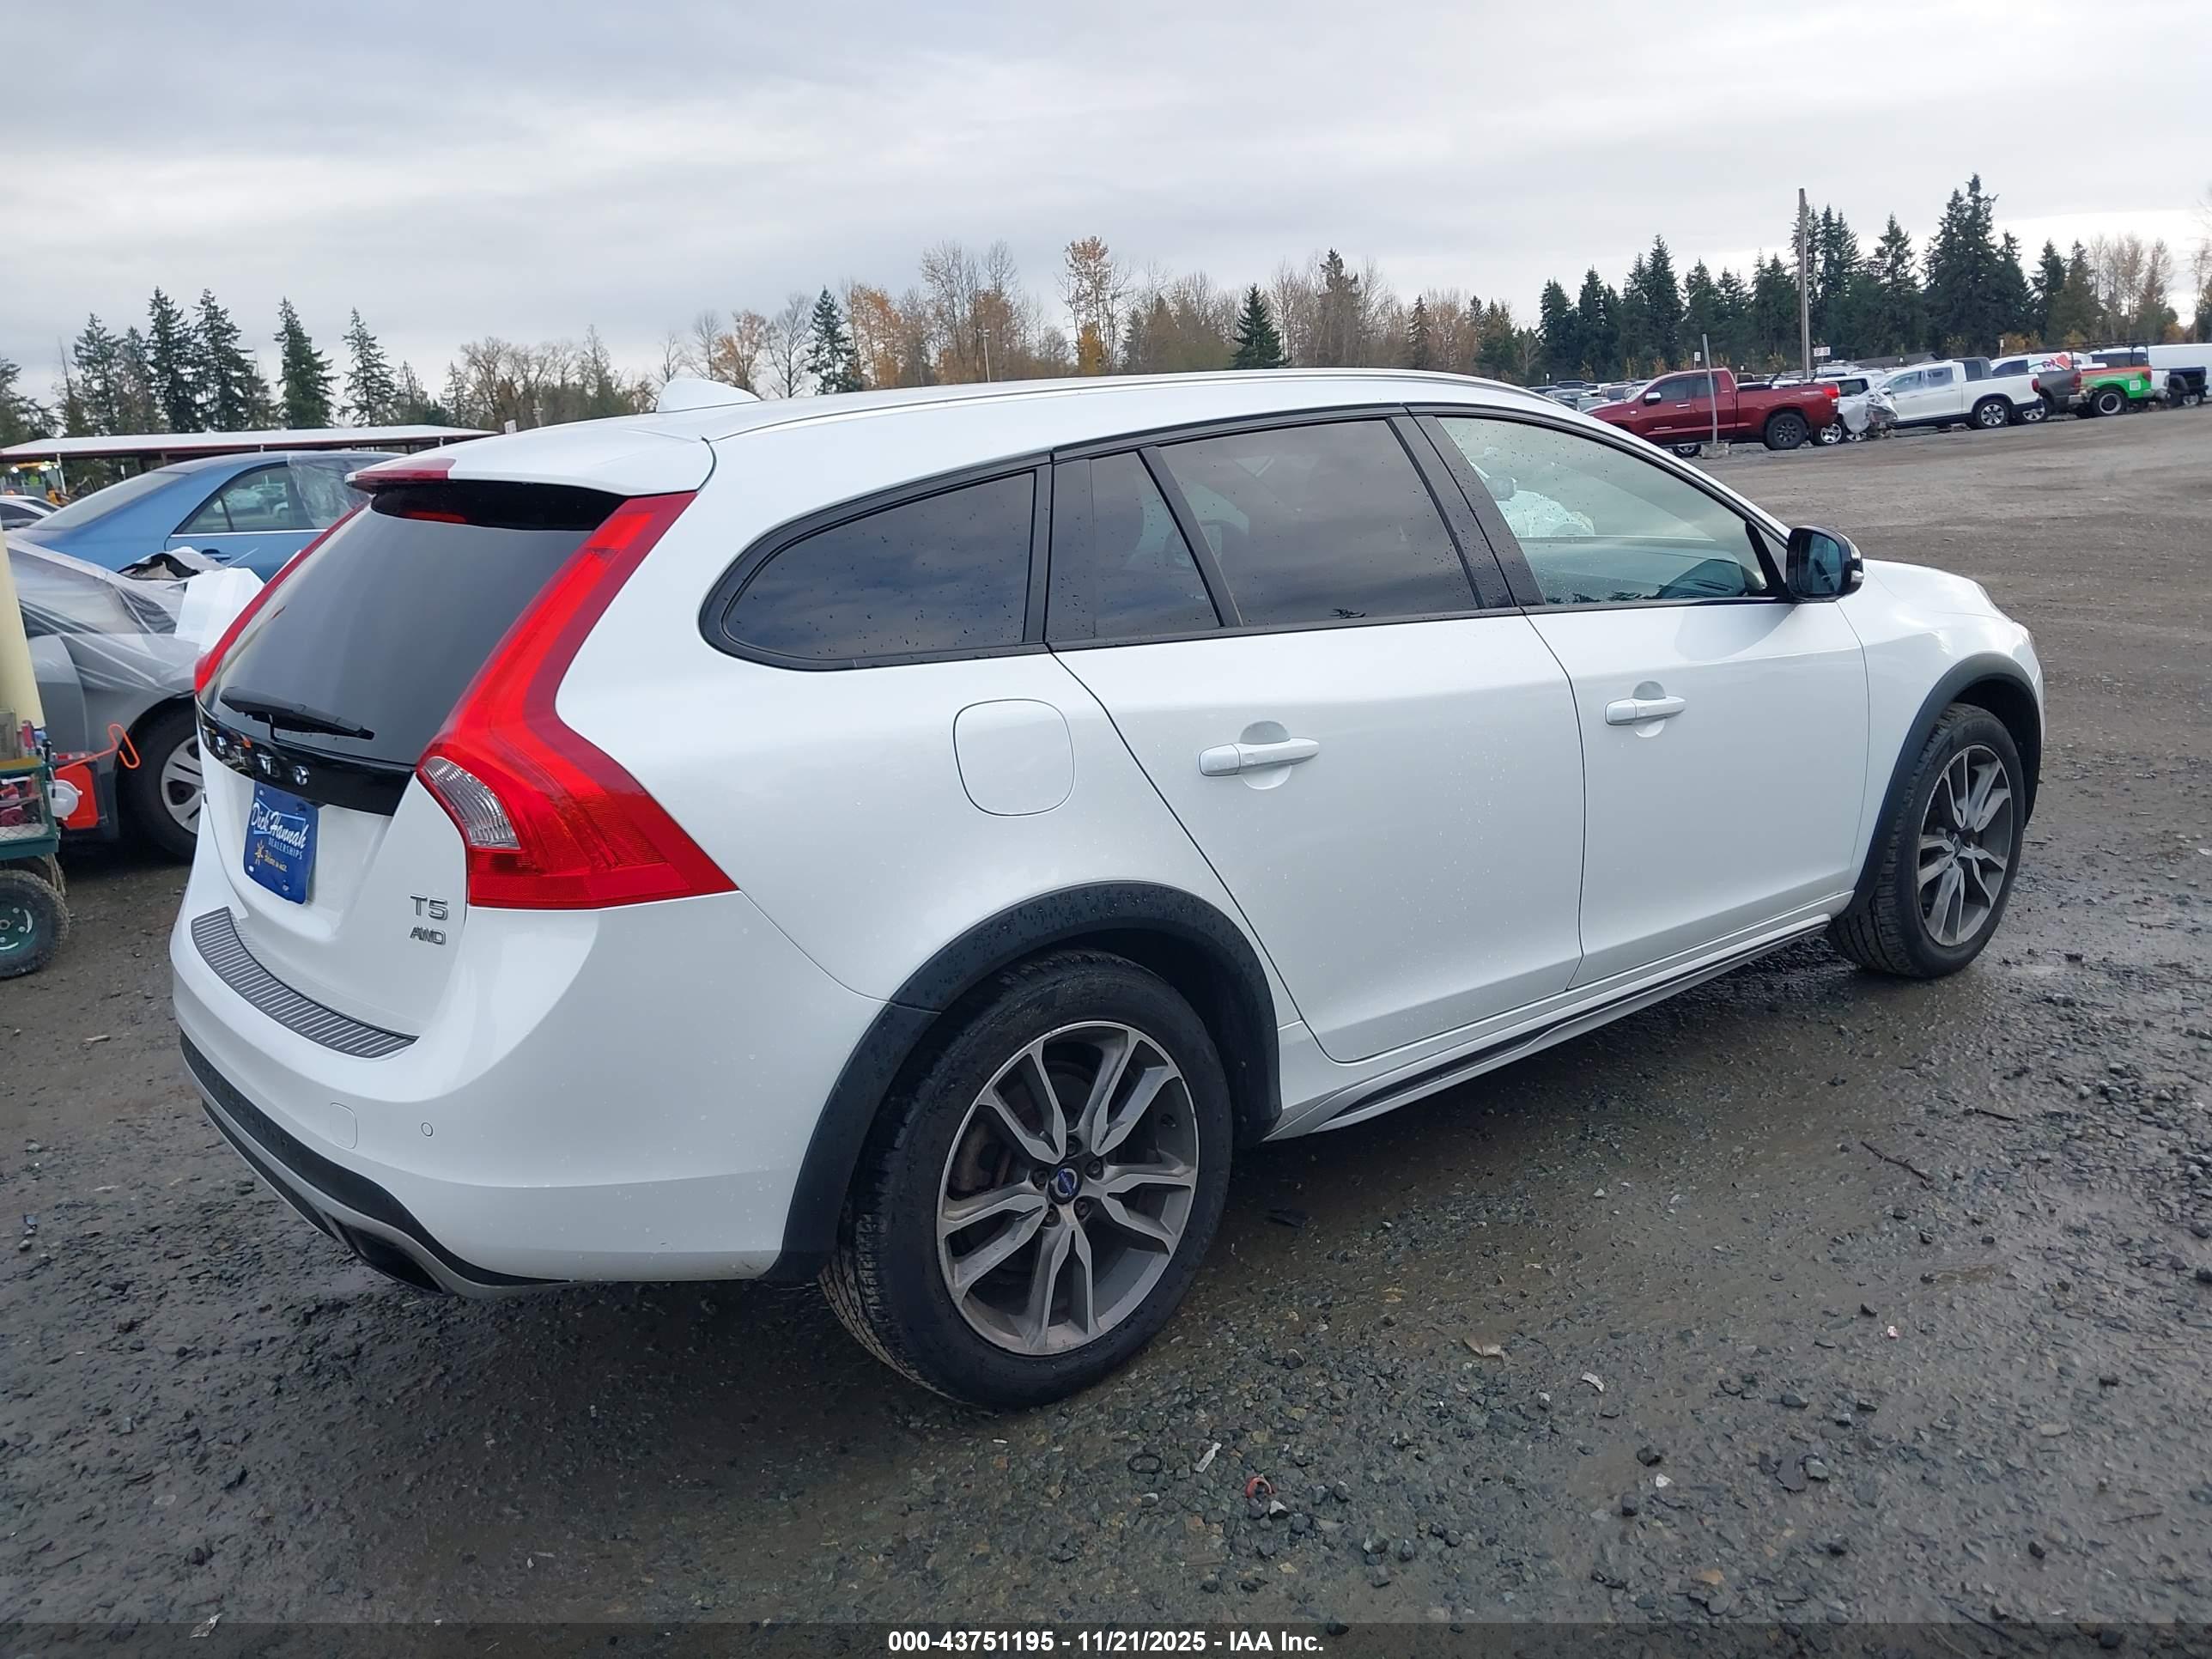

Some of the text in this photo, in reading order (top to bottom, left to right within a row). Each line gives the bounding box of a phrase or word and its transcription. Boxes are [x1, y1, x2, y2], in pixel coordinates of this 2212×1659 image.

[251, 801, 309, 848] Dick Hannah
[268, 837, 303, 860] DEALERSHIPS
[410, 893, 448, 921] T5
[410, 927, 447, 945] AWD
